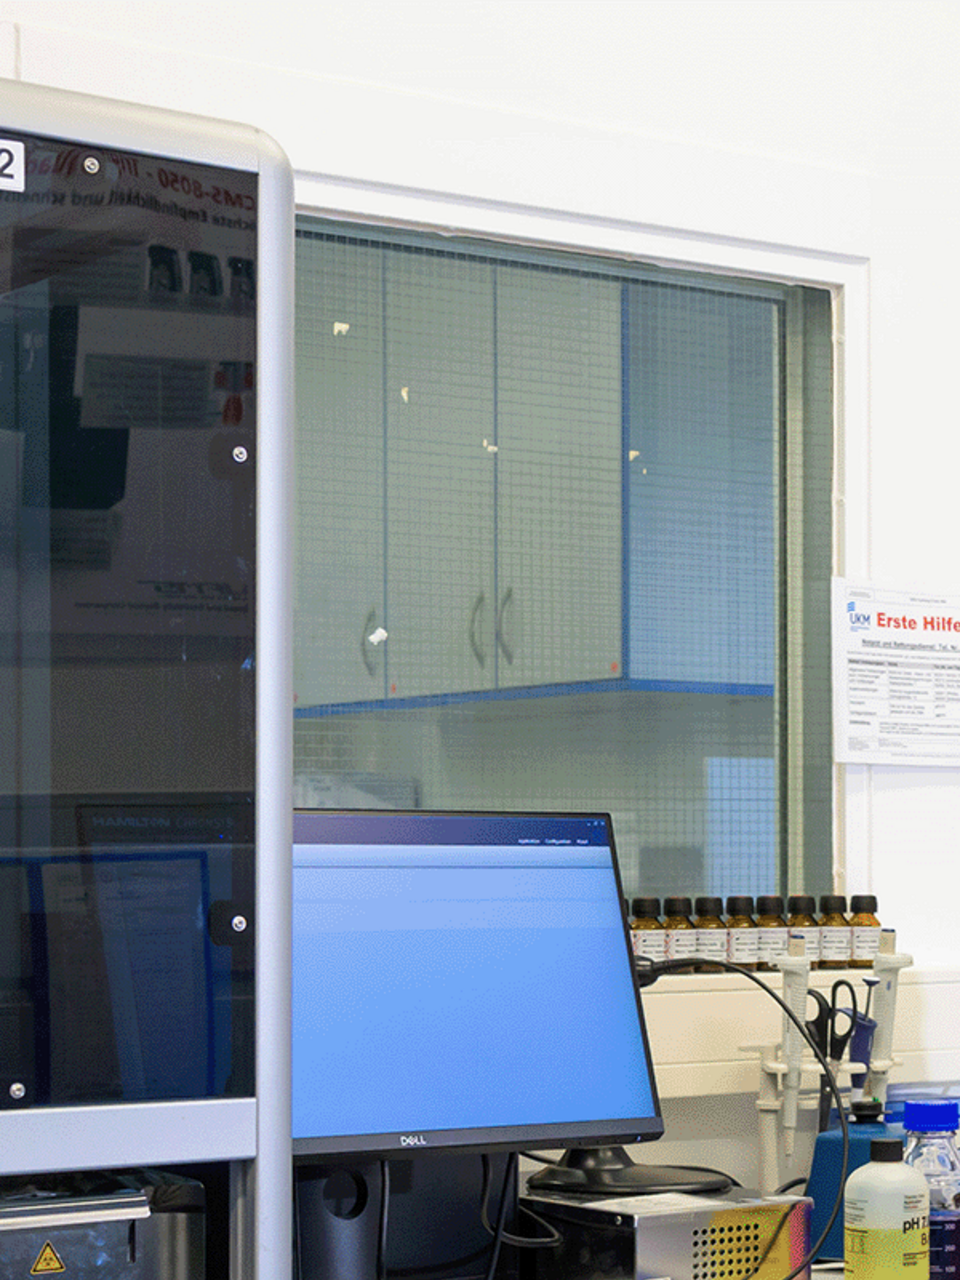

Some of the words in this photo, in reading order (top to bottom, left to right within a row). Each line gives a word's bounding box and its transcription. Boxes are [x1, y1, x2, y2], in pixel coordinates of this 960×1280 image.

[0, 148, 14, 180] 2
[849, 612, 870, 626] UKM
[876, 611, 917, 631] Erste
[399, 1134, 428, 1147] DELL
[902, 1217, 920, 1235] pH
